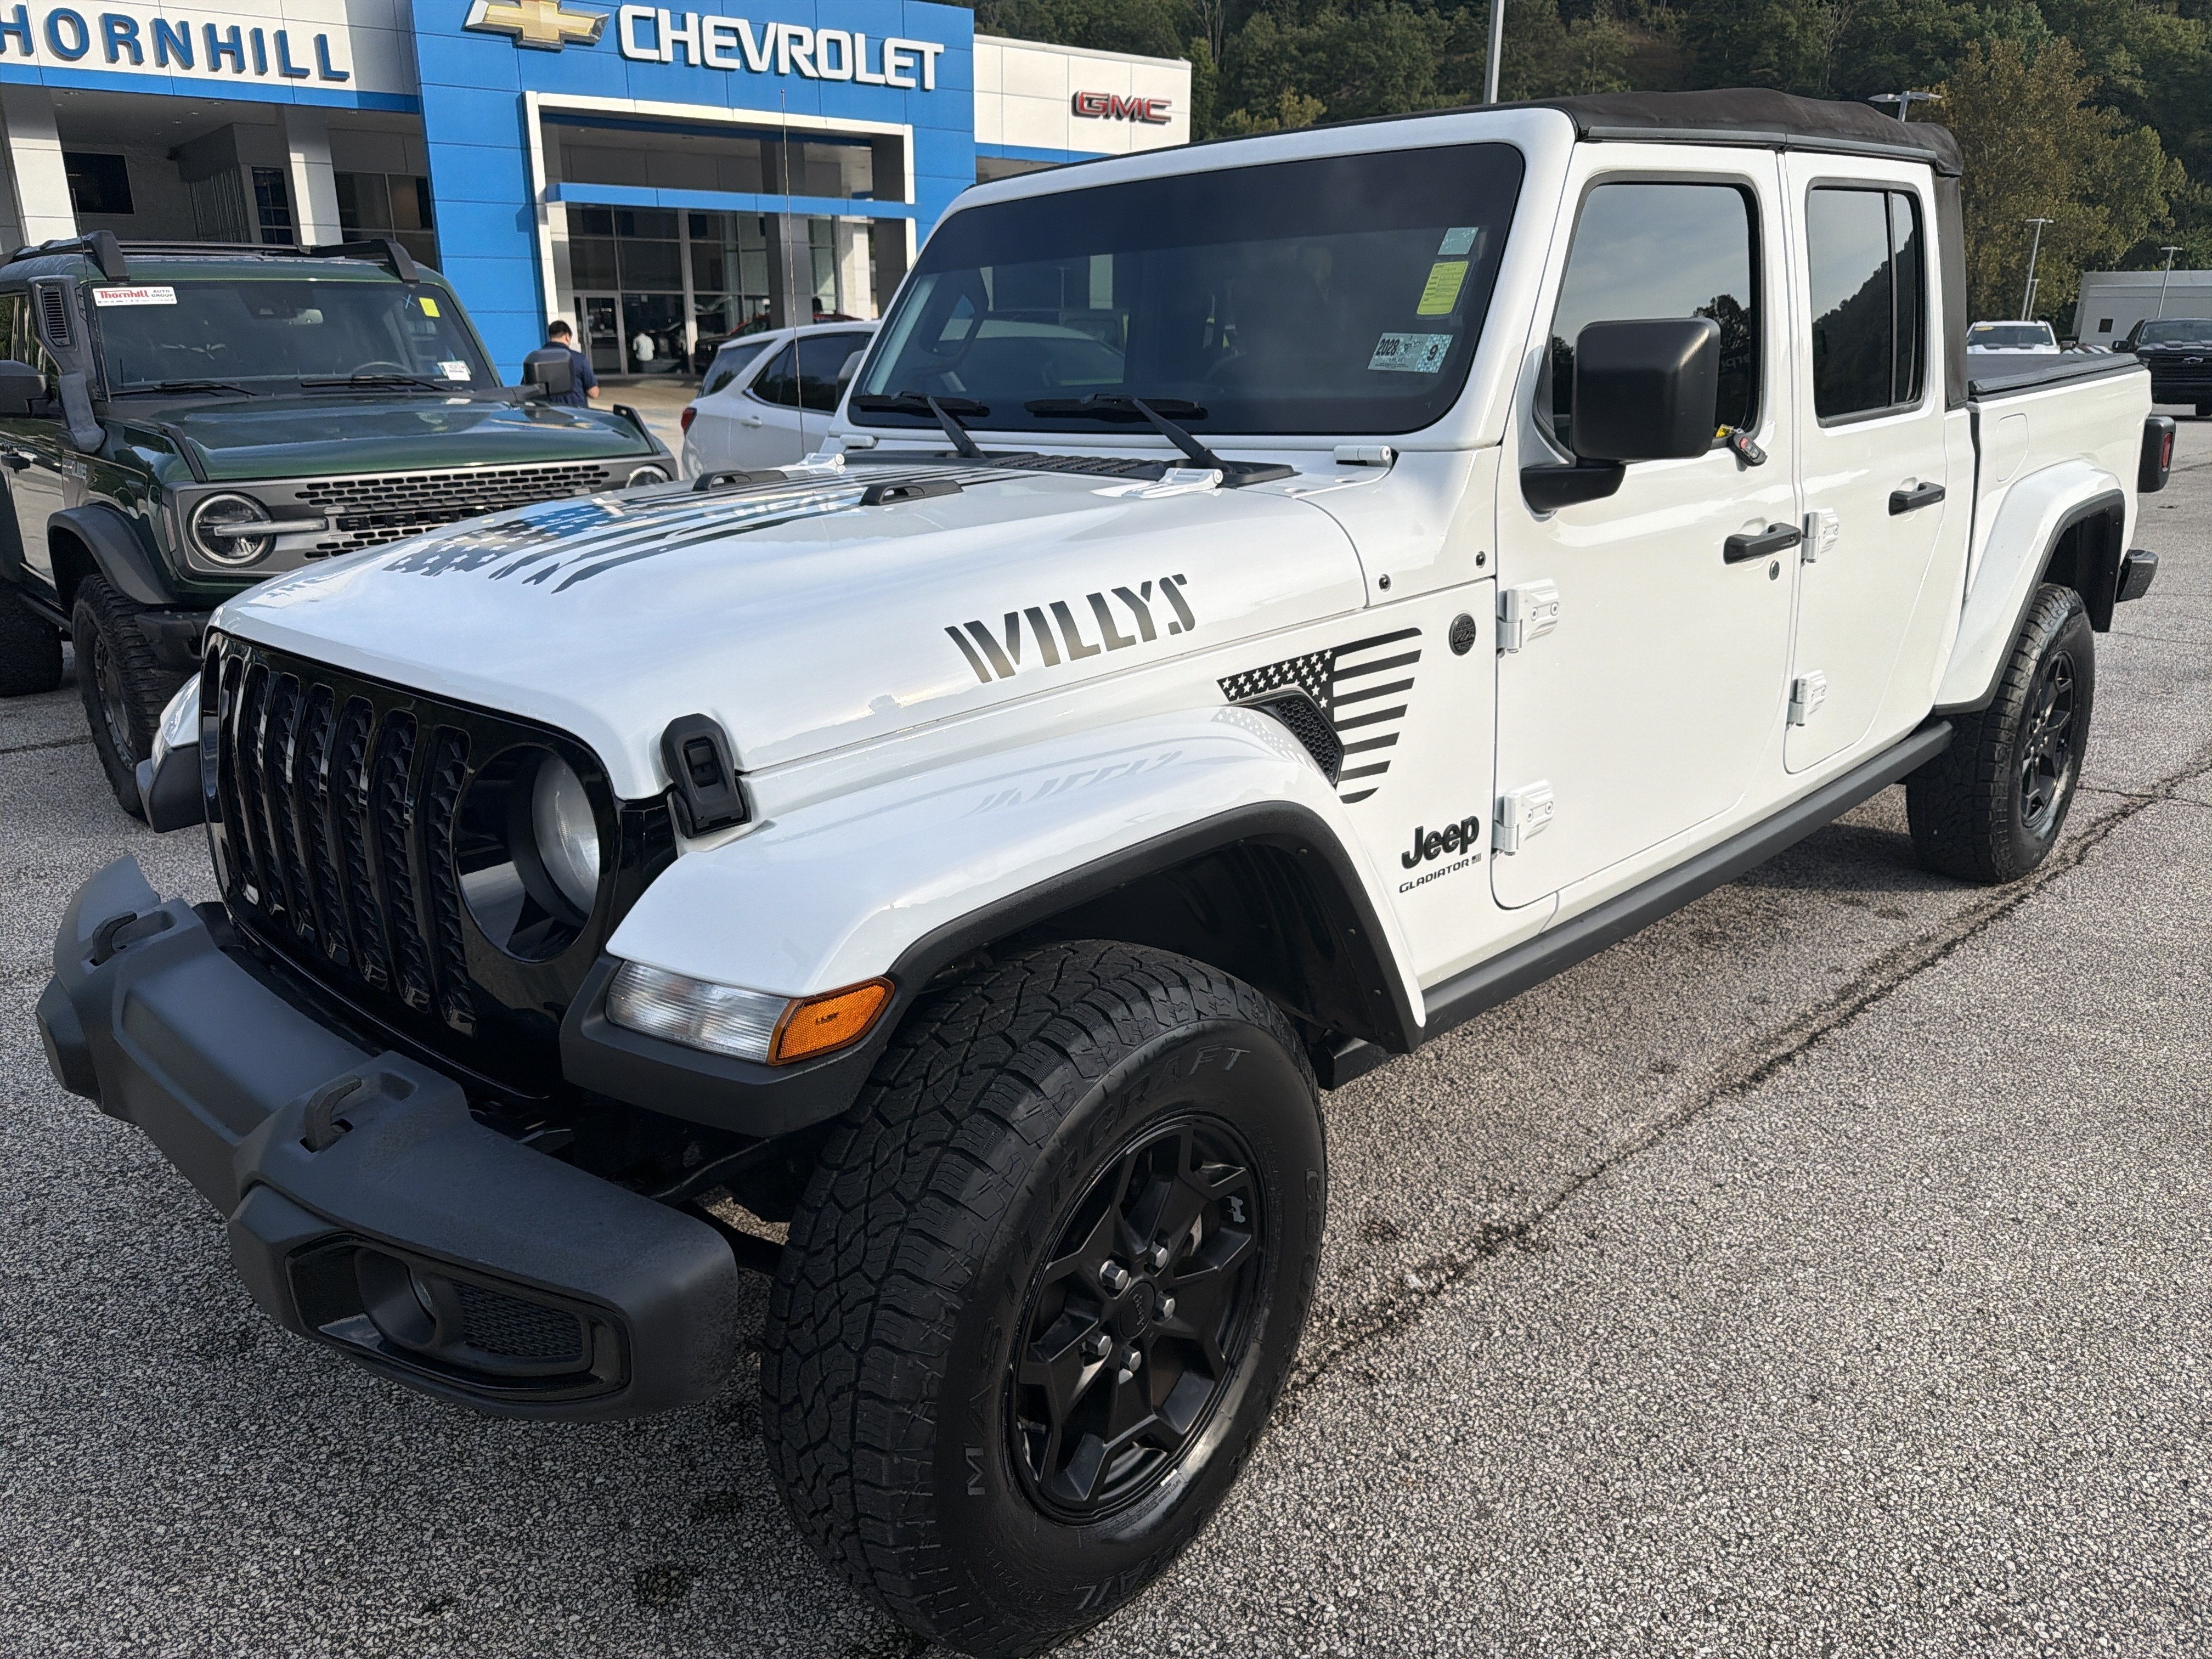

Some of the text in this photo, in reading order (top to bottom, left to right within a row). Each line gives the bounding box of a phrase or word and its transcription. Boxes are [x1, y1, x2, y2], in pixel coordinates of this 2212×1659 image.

[619, 4, 945, 90] CHEVROLET
[1073, 91, 1172, 125] GMC
[95, 290, 149, 298] Thornhill
[944, 573, 1195, 684] WILLYS
[1401, 815, 1480, 869] Jeep
[1399, 858, 1470, 894] GLADIATOR
